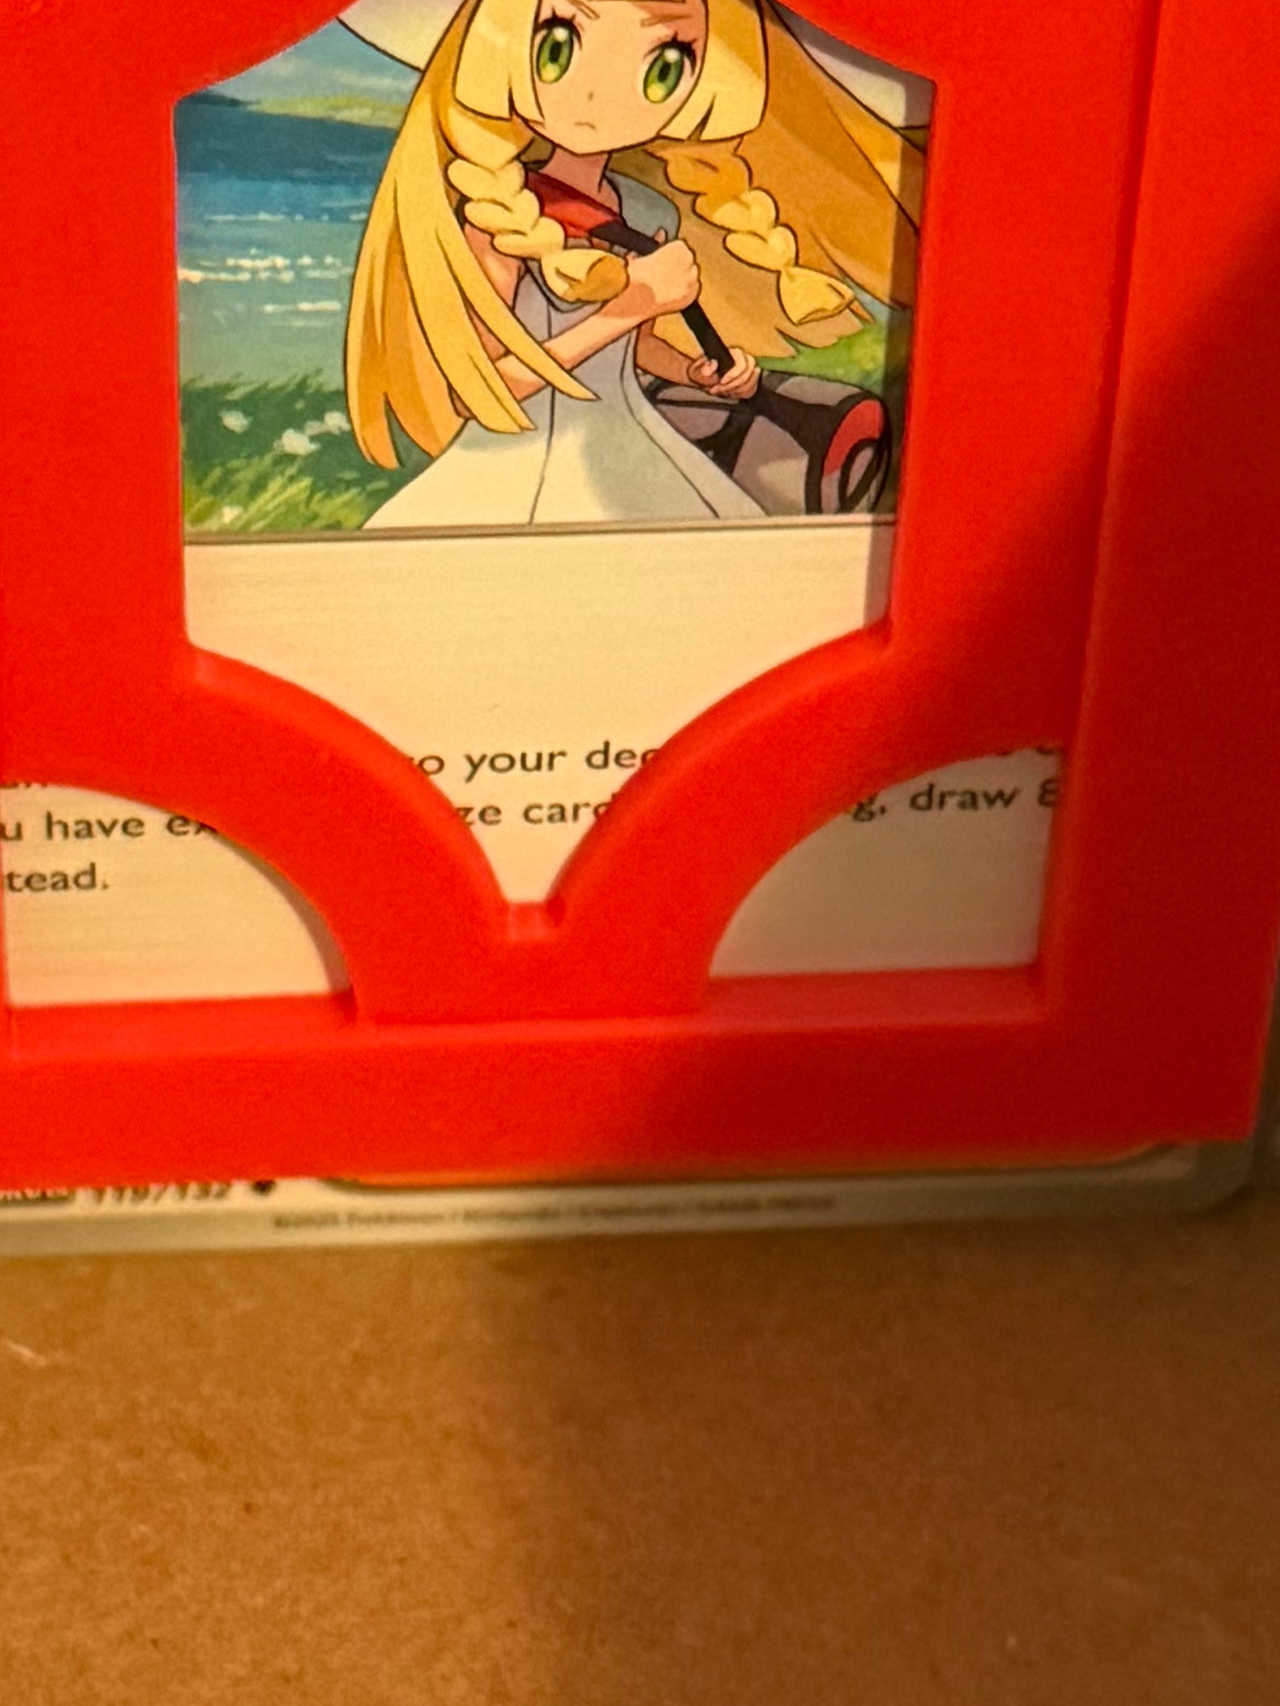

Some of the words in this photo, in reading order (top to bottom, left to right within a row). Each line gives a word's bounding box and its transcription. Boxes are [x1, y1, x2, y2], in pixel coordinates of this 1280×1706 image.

[464, 750, 568, 783] your
[45, 811, 145, 841] have
[909, 782, 1021, 812] draw
